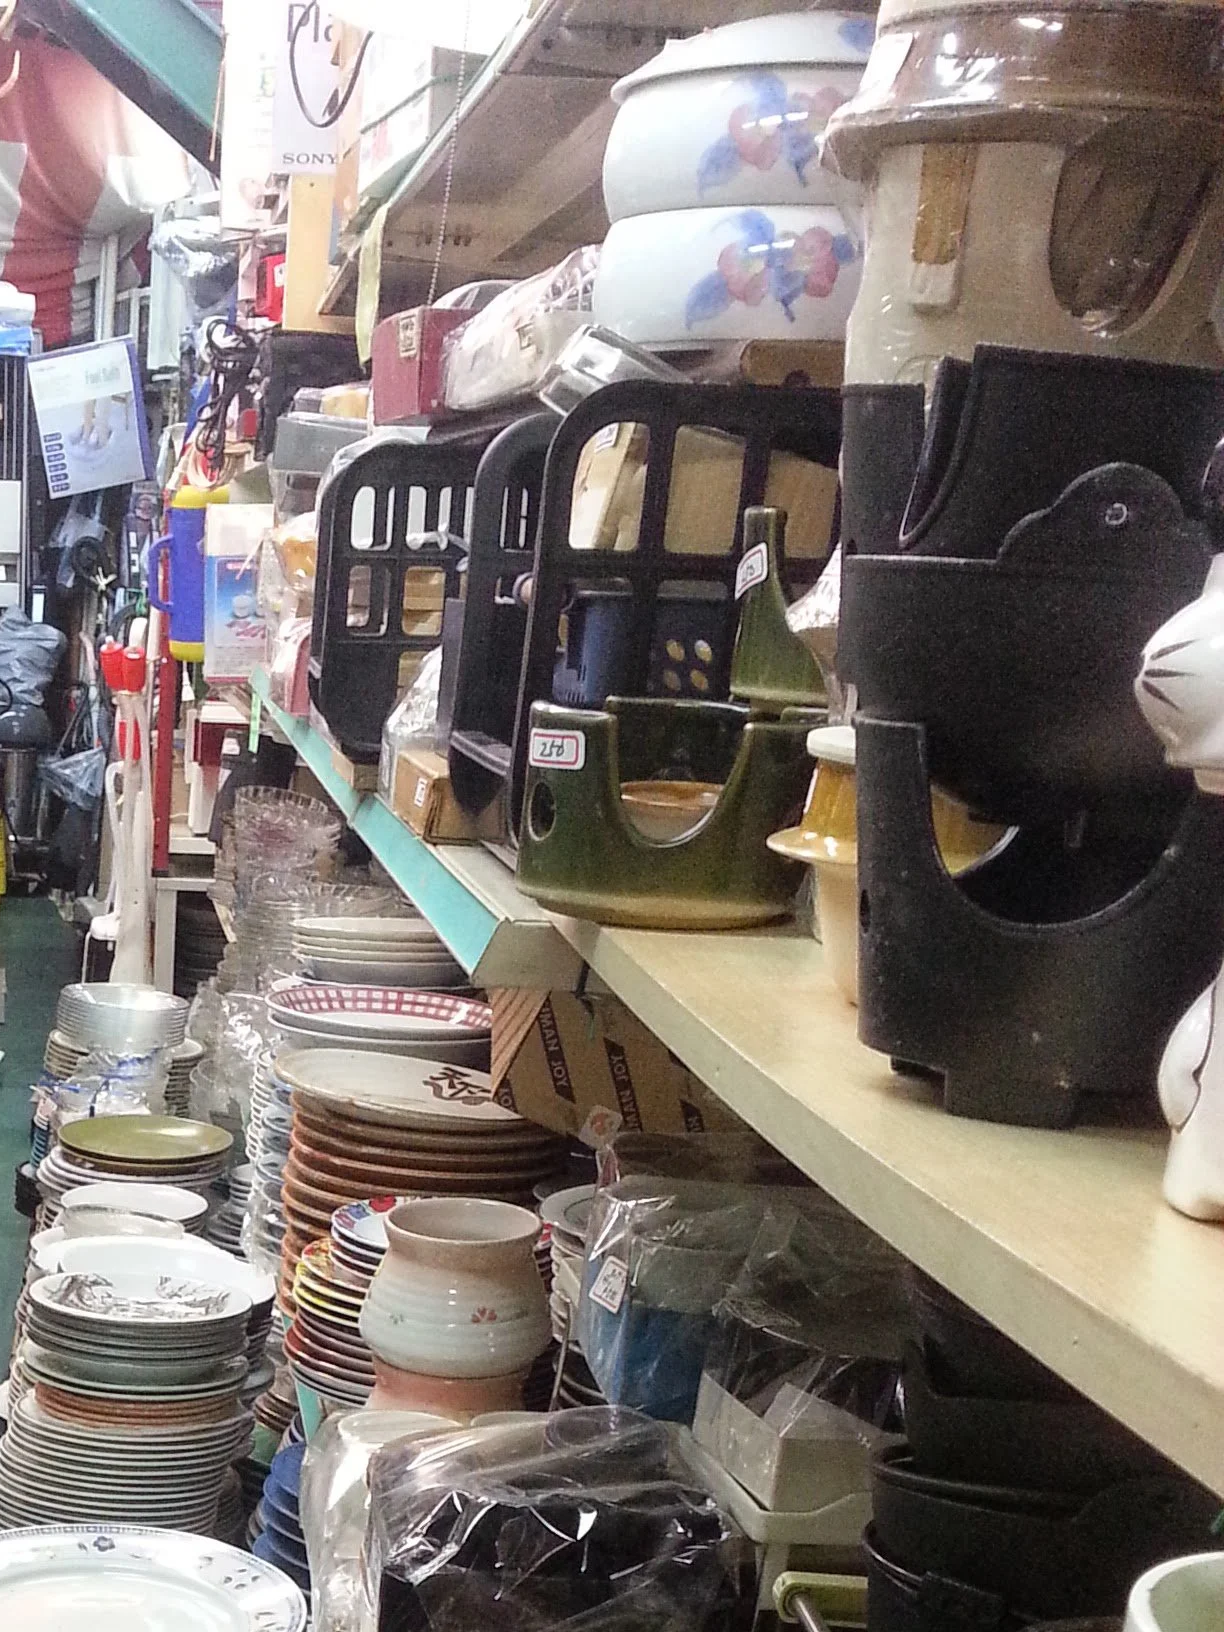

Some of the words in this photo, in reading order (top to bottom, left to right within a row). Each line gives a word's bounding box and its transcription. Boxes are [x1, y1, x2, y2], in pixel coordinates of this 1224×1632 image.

[282, 152, 337, 165] SONY
[551, 1060, 569, 1087] JOY
[609, 1053, 629, 1082] JOY
